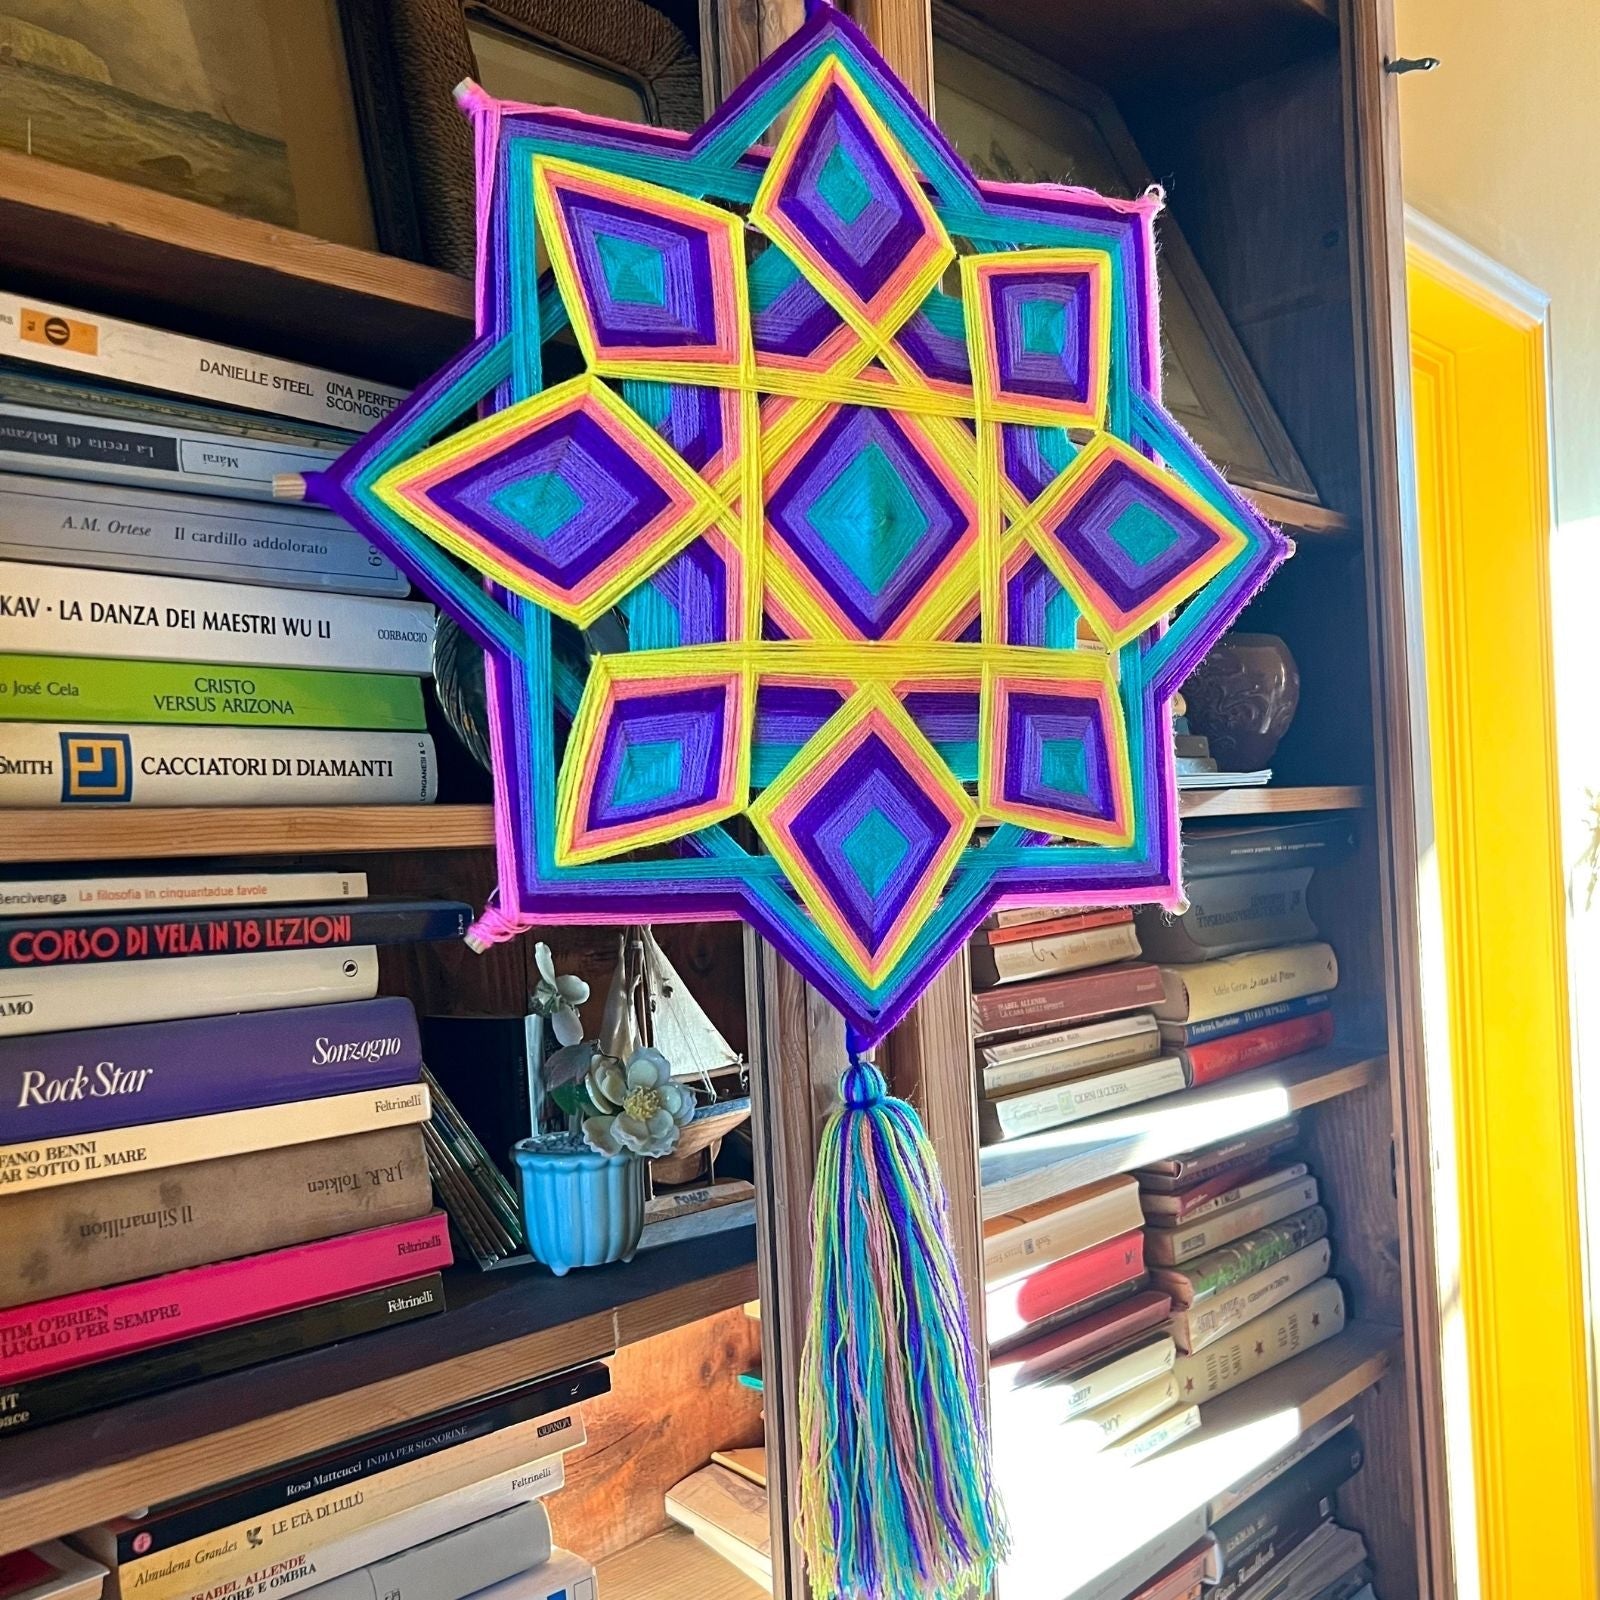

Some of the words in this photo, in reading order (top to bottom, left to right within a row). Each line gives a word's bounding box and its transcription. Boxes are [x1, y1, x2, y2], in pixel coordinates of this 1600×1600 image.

[200, 358, 269, 386] DANIELLE
[272, 376, 314, 397] STEEL
[326, 381, 354, 399] UNA
[66, 435, 82, 448] di
[88, 437, 130, 452] recita
[137, 443, 155, 459] La
[202, 452, 239, 468] Márai
[62, 515, 78, 530] A.
[80, 517, 101, 532] M.
[107, 519, 152, 537] Ortese
[175, 526, 185, 541] Il
[191, 530, 247, 547] cardillo
[252, 536, 329, 555] addolorato
[0, 594, 40, 617] KAV
[59, 599, 83, 621] LA
[90, 602, 160, 627] DANZA
[166, 608, 196, 630] DEI
[202, 610, 277, 635] MAESTRI
[282, 616, 312, 638] WU
[318, 620, 332, 639] LI
[377, 628, 428, 643] CORBACCIO
[13, 680, 41, 697] José
[47, 681, 80, 697] Cela
[194, 677, 256, 696] CRISTO
[153, 694, 216, 713] VERSUS
[222, 698, 295, 715] ARIZONA
[140, 756, 268, 777] CACCIATORI
[272, 758, 292, 777] DI
[296, 758, 394, 777] DIAMANTI
[79, 889, 93, 902] La
[97, 888, 142, 902] filosofia
[145, 887, 157, 899] in
[159, 886, 234, 899] cinquantadue
[237, 884, 268, 896] favole
[9, 926, 121, 963] CORSO
[127, 925, 149, 957] DI
[153, 922, 204, 953] VELA
[208, 920, 229, 950] IN
[233, 919, 261, 949] 18
[265, 915, 351, 947] LEZIONI
[312, 1036, 402, 1065] Sonzogno
[17, 1065, 89, 1108] Rock
[90, 1061, 154, 1097] Star
[375, 1094, 422, 1113] Feltrinelli
[46, 1140, 97, 1161] BENNI
[26, 1158, 80, 1180] SOTTO
[85, 1156, 101, 1170] IL
[104, 1147, 147, 1167] MARE
[366, 1160, 404, 1186] J.R.R.
[308, 1172, 360, 1196] Tolkien
[79, 1206, 178, 1240] Silmarillion
[183, 1205, 193, 1224] Il
[397, 1234, 442, 1257] Feltrinelli
[387, 1290, 434, 1314] Feltrinelli
[0, 1321, 33, 1343] TIM
[38, 1304, 110, 1333] O'BRIEN
[1, 1329, 71, 1360] LUGLIO
[75, 1320, 110, 1342] PER
[113, 1303, 182, 1332] SEMPRE
[286, 1479, 312, 1497] Rosa
[313, 1461, 363, 1488] Matteucci
[366, 1451, 396, 1469] INDIA
[395, 1443, 415, 1459] PER
[415, 1425, 468, 1450] SIGNORINE
[511, 1467, 552, 1491] Feltrinelli
[133, 1557, 191, 1589] Almudena
[194, 1541, 238, 1565] Grandes
[271, 1519, 289, 1537] LE
[291, 1509, 314, 1530] ETÀ
[316, 1507, 331, 1520] DI
[332, 1491, 364, 1515] LULÙ
[245, 1554, 306, 1586] ALLENDE
[257, 1581, 267, 1594] E
[270, 1563, 317, 1589] OMBRA
